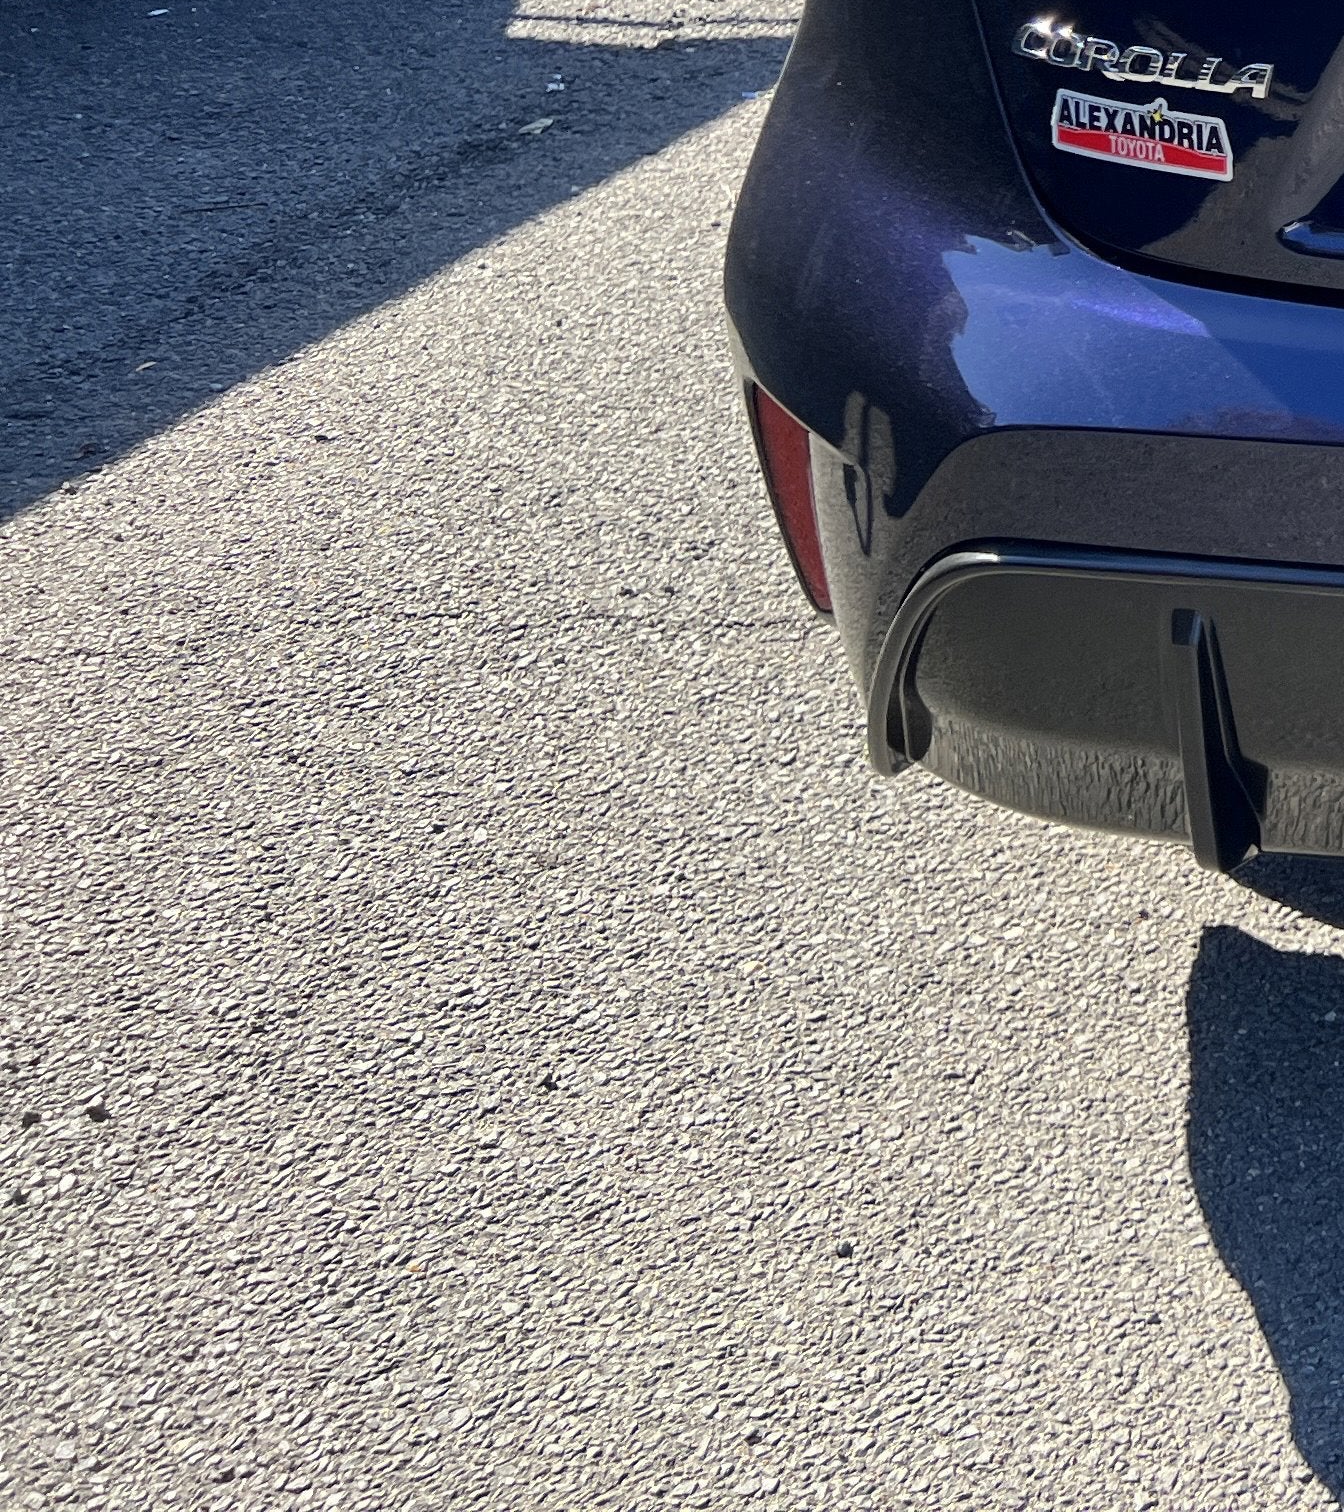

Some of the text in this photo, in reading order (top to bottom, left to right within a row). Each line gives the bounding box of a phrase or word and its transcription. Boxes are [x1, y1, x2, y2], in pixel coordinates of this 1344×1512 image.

[1013, 19, 1275, 99] COROLLA
[1058, 97, 1225, 155] ALEXANDRIA
[1108, 134, 1166, 163] TOYOTA
